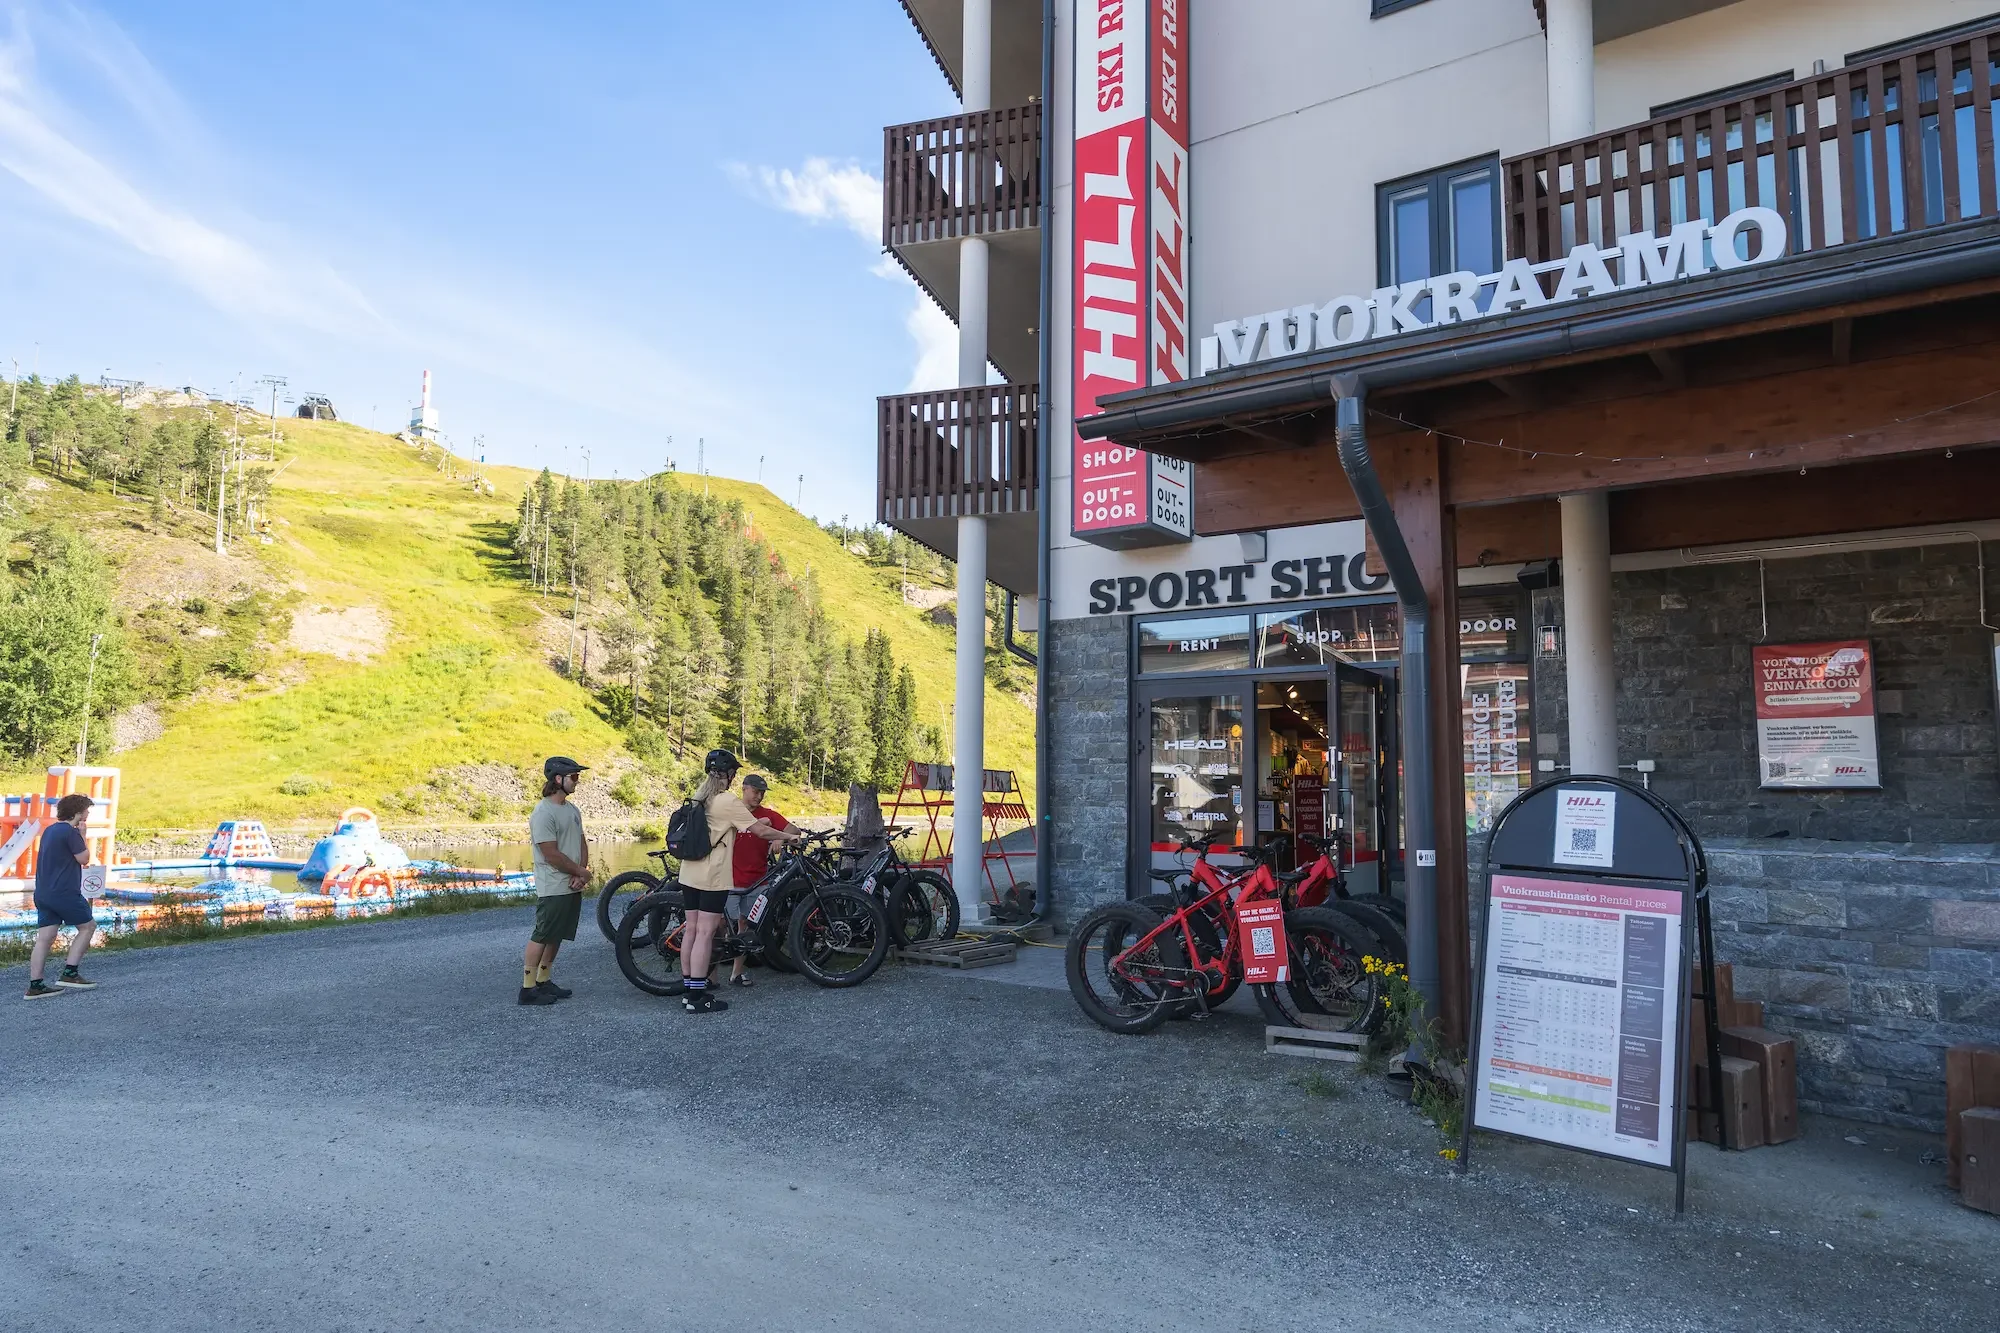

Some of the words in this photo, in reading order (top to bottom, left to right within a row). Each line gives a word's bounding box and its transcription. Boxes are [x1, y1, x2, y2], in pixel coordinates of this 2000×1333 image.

[1097, 42, 1123, 113] SKI
[1162, 48, 1177, 124] SKI
[1084, 136, 1137, 385] HILL
[1156, 151, 1184, 384] HILL
[1214, 206, 1787, 366] VUOKRAAMO
[1083, 446, 1137, 469] SHOP
[1083, 487, 1133, 505] OUT-
[1157, 488, 1183, 507] OUT-
[1083, 503, 1137, 524] DOOR
[1157, 504, 1185, 528] DOOR
[1089, 564, 1254, 615] SPORT
[1271, 551, 1393, 599] SHO
[1460, 617, 1517, 633] DOOR
[1181, 638, 1219, 652] RENT
[1297, 629, 1342, 645] SHOP
[1763, 664, 1860, 680] VERKOSSA
[1763, 678, 1860, 691] ENNAKKOON
[1500, 679, 1518, 772] NATURE
[1164, 739, 1227, 750] HEAD
[1835, 766, 1867, 774] HILL
[1567, 797, 1606, 806] HILL
[1192, 813, 1228, 821] HESTRA
[1502, 885, 1597, 903] Vuokraushinnasto
[1600, 894, 1633, 906] Rental
[1635, 897, 1667, 910] prices
[749, 896, 766, 920] HILL
[1247, 967, 1268, 975] HILL
